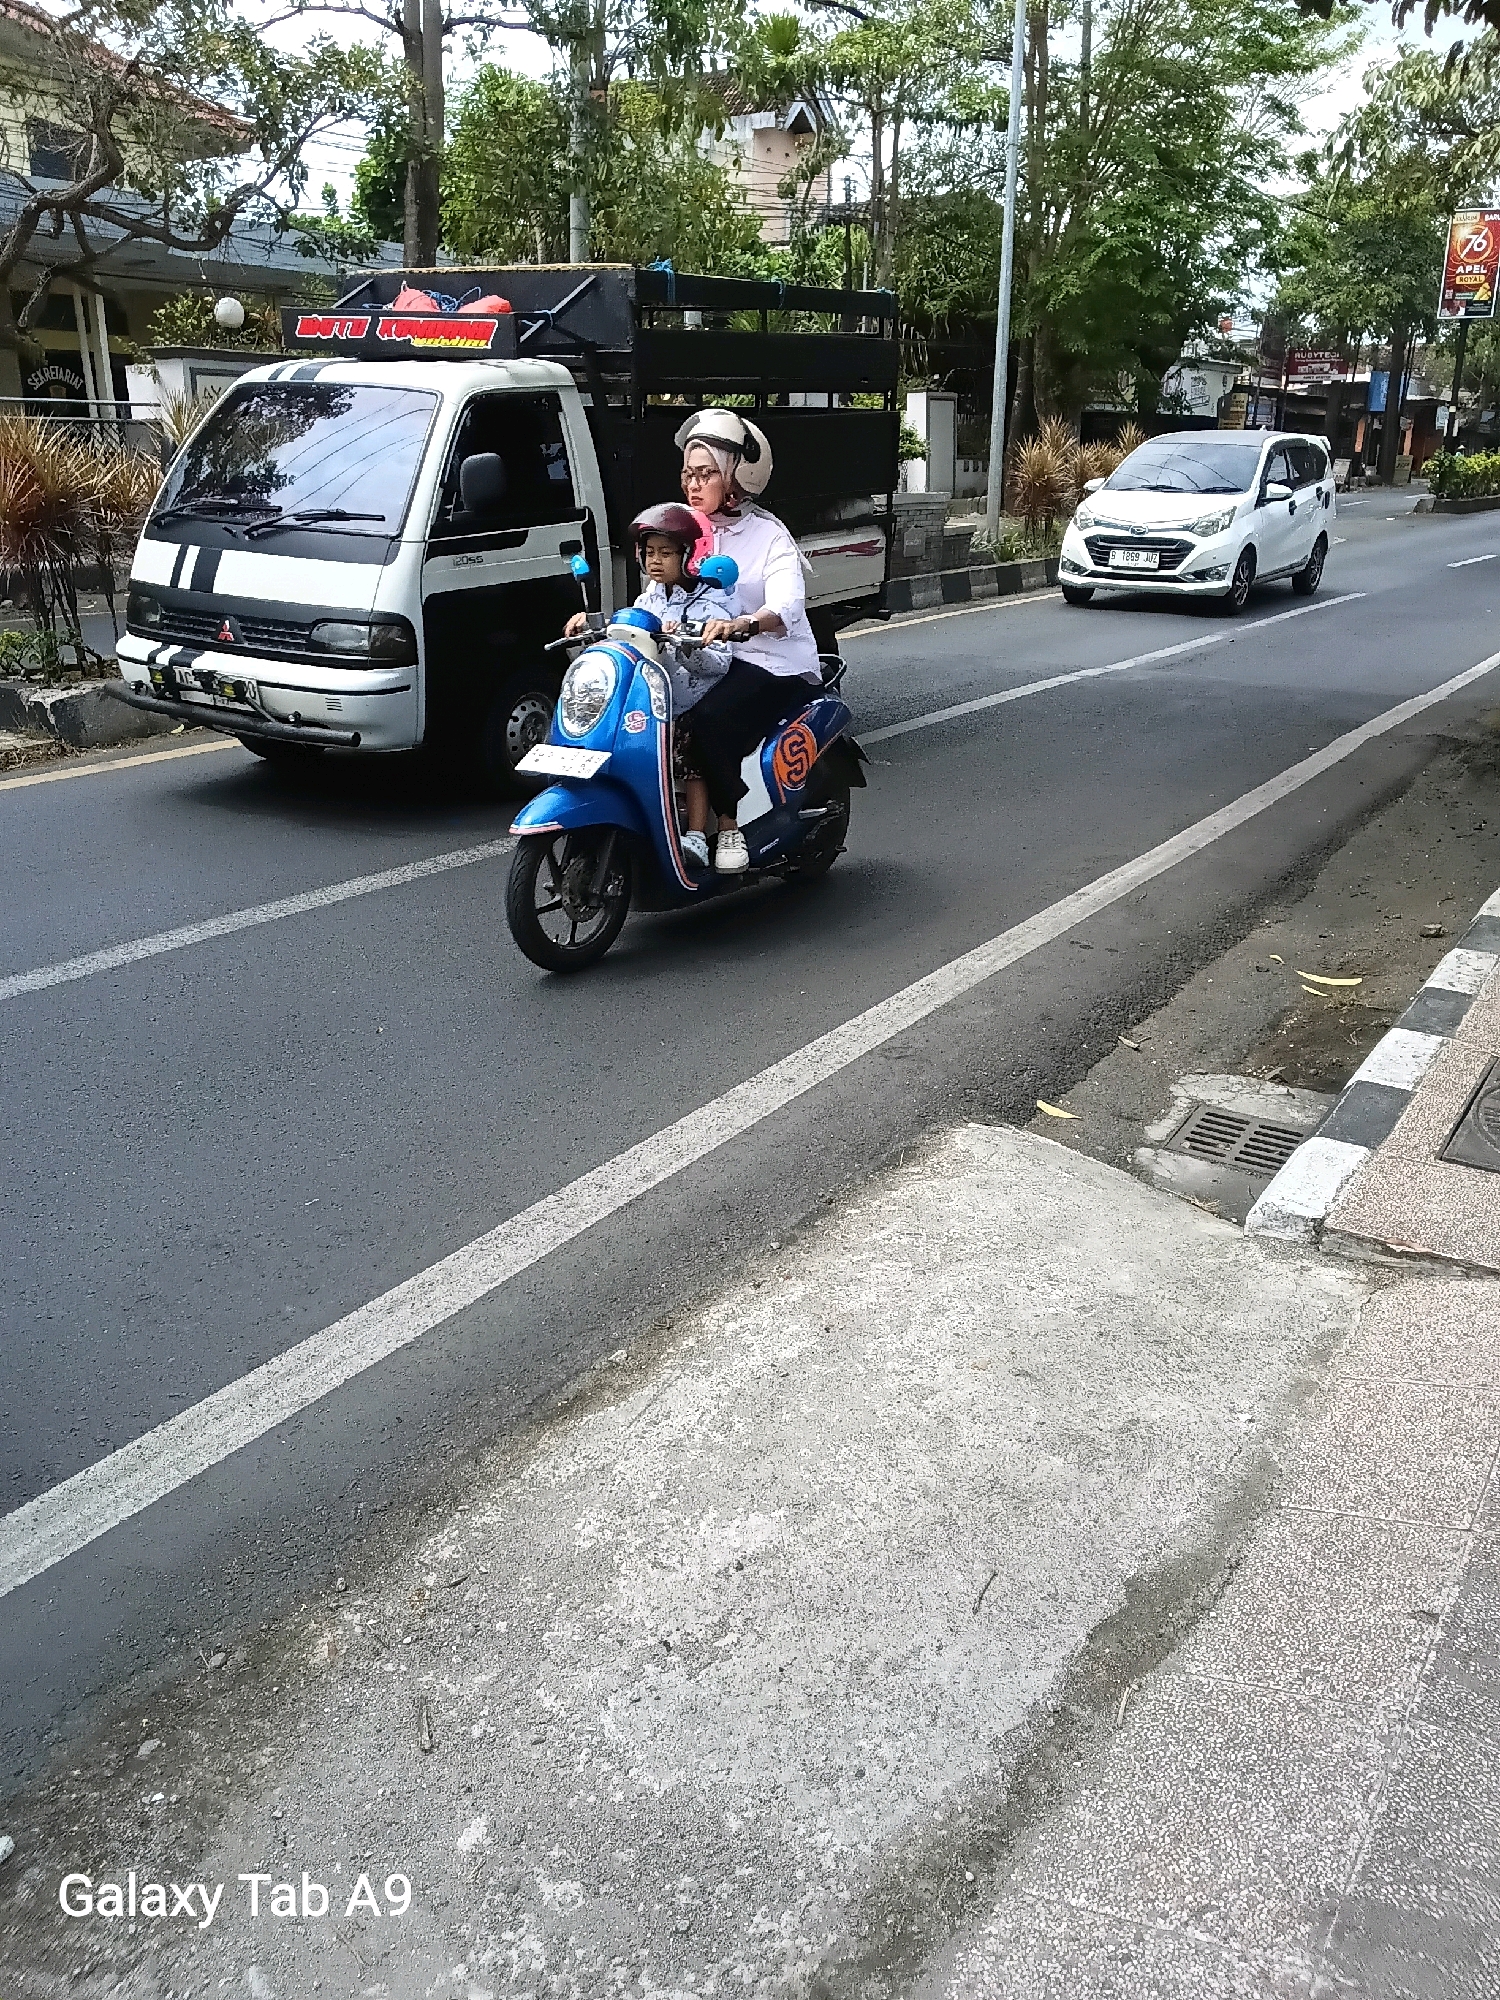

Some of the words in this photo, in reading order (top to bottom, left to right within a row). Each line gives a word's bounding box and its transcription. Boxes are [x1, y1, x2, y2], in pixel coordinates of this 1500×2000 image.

[1460, 227, 1489, 259] 76
[1456, 265, 1487, 274] APEL
[1459, 275, 1483, 283] ROYAL
[27, 365, 84, 391] SEKRETARIAT
